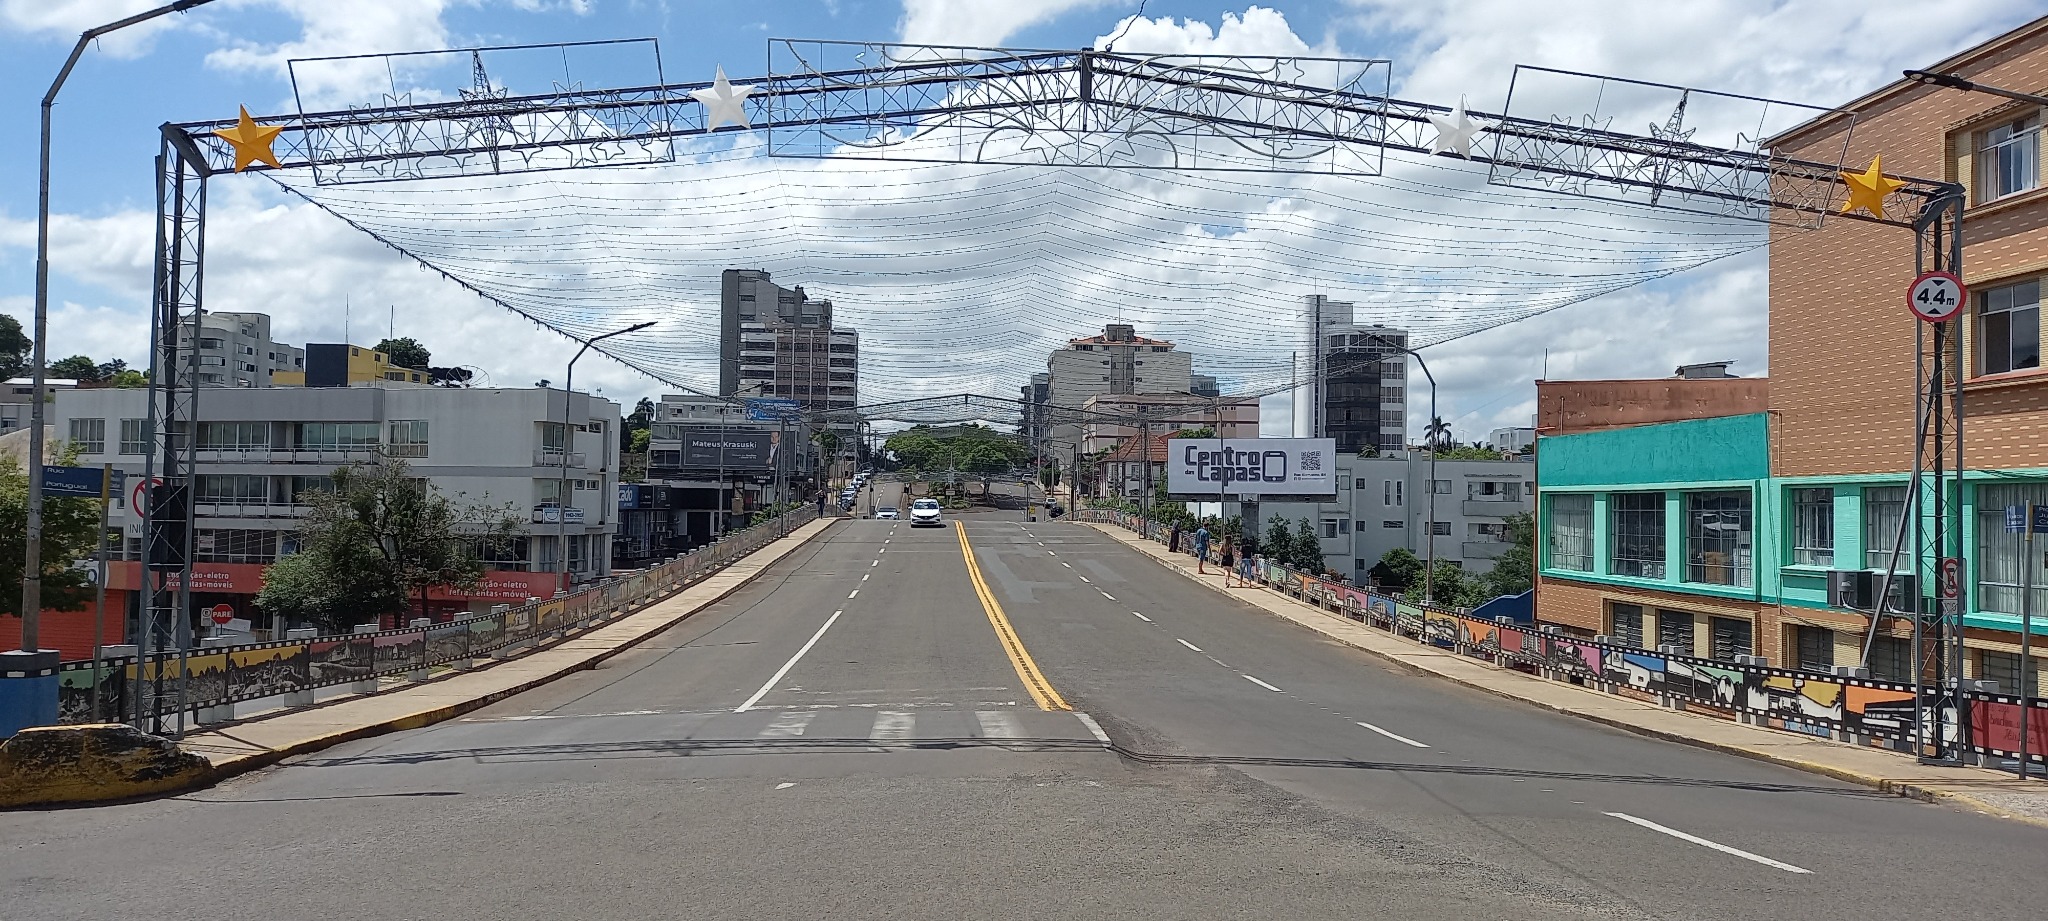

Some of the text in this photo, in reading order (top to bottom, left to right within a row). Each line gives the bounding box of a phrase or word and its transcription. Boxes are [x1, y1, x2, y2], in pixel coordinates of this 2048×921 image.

[1185, 446, 1260, 466] Centro
[1198, 461, 1260, 486] Capas
[129, 523, 144, 534] INI
[206, 581, 233, 589] móveis
[502, 590, 532, 598] móveis
